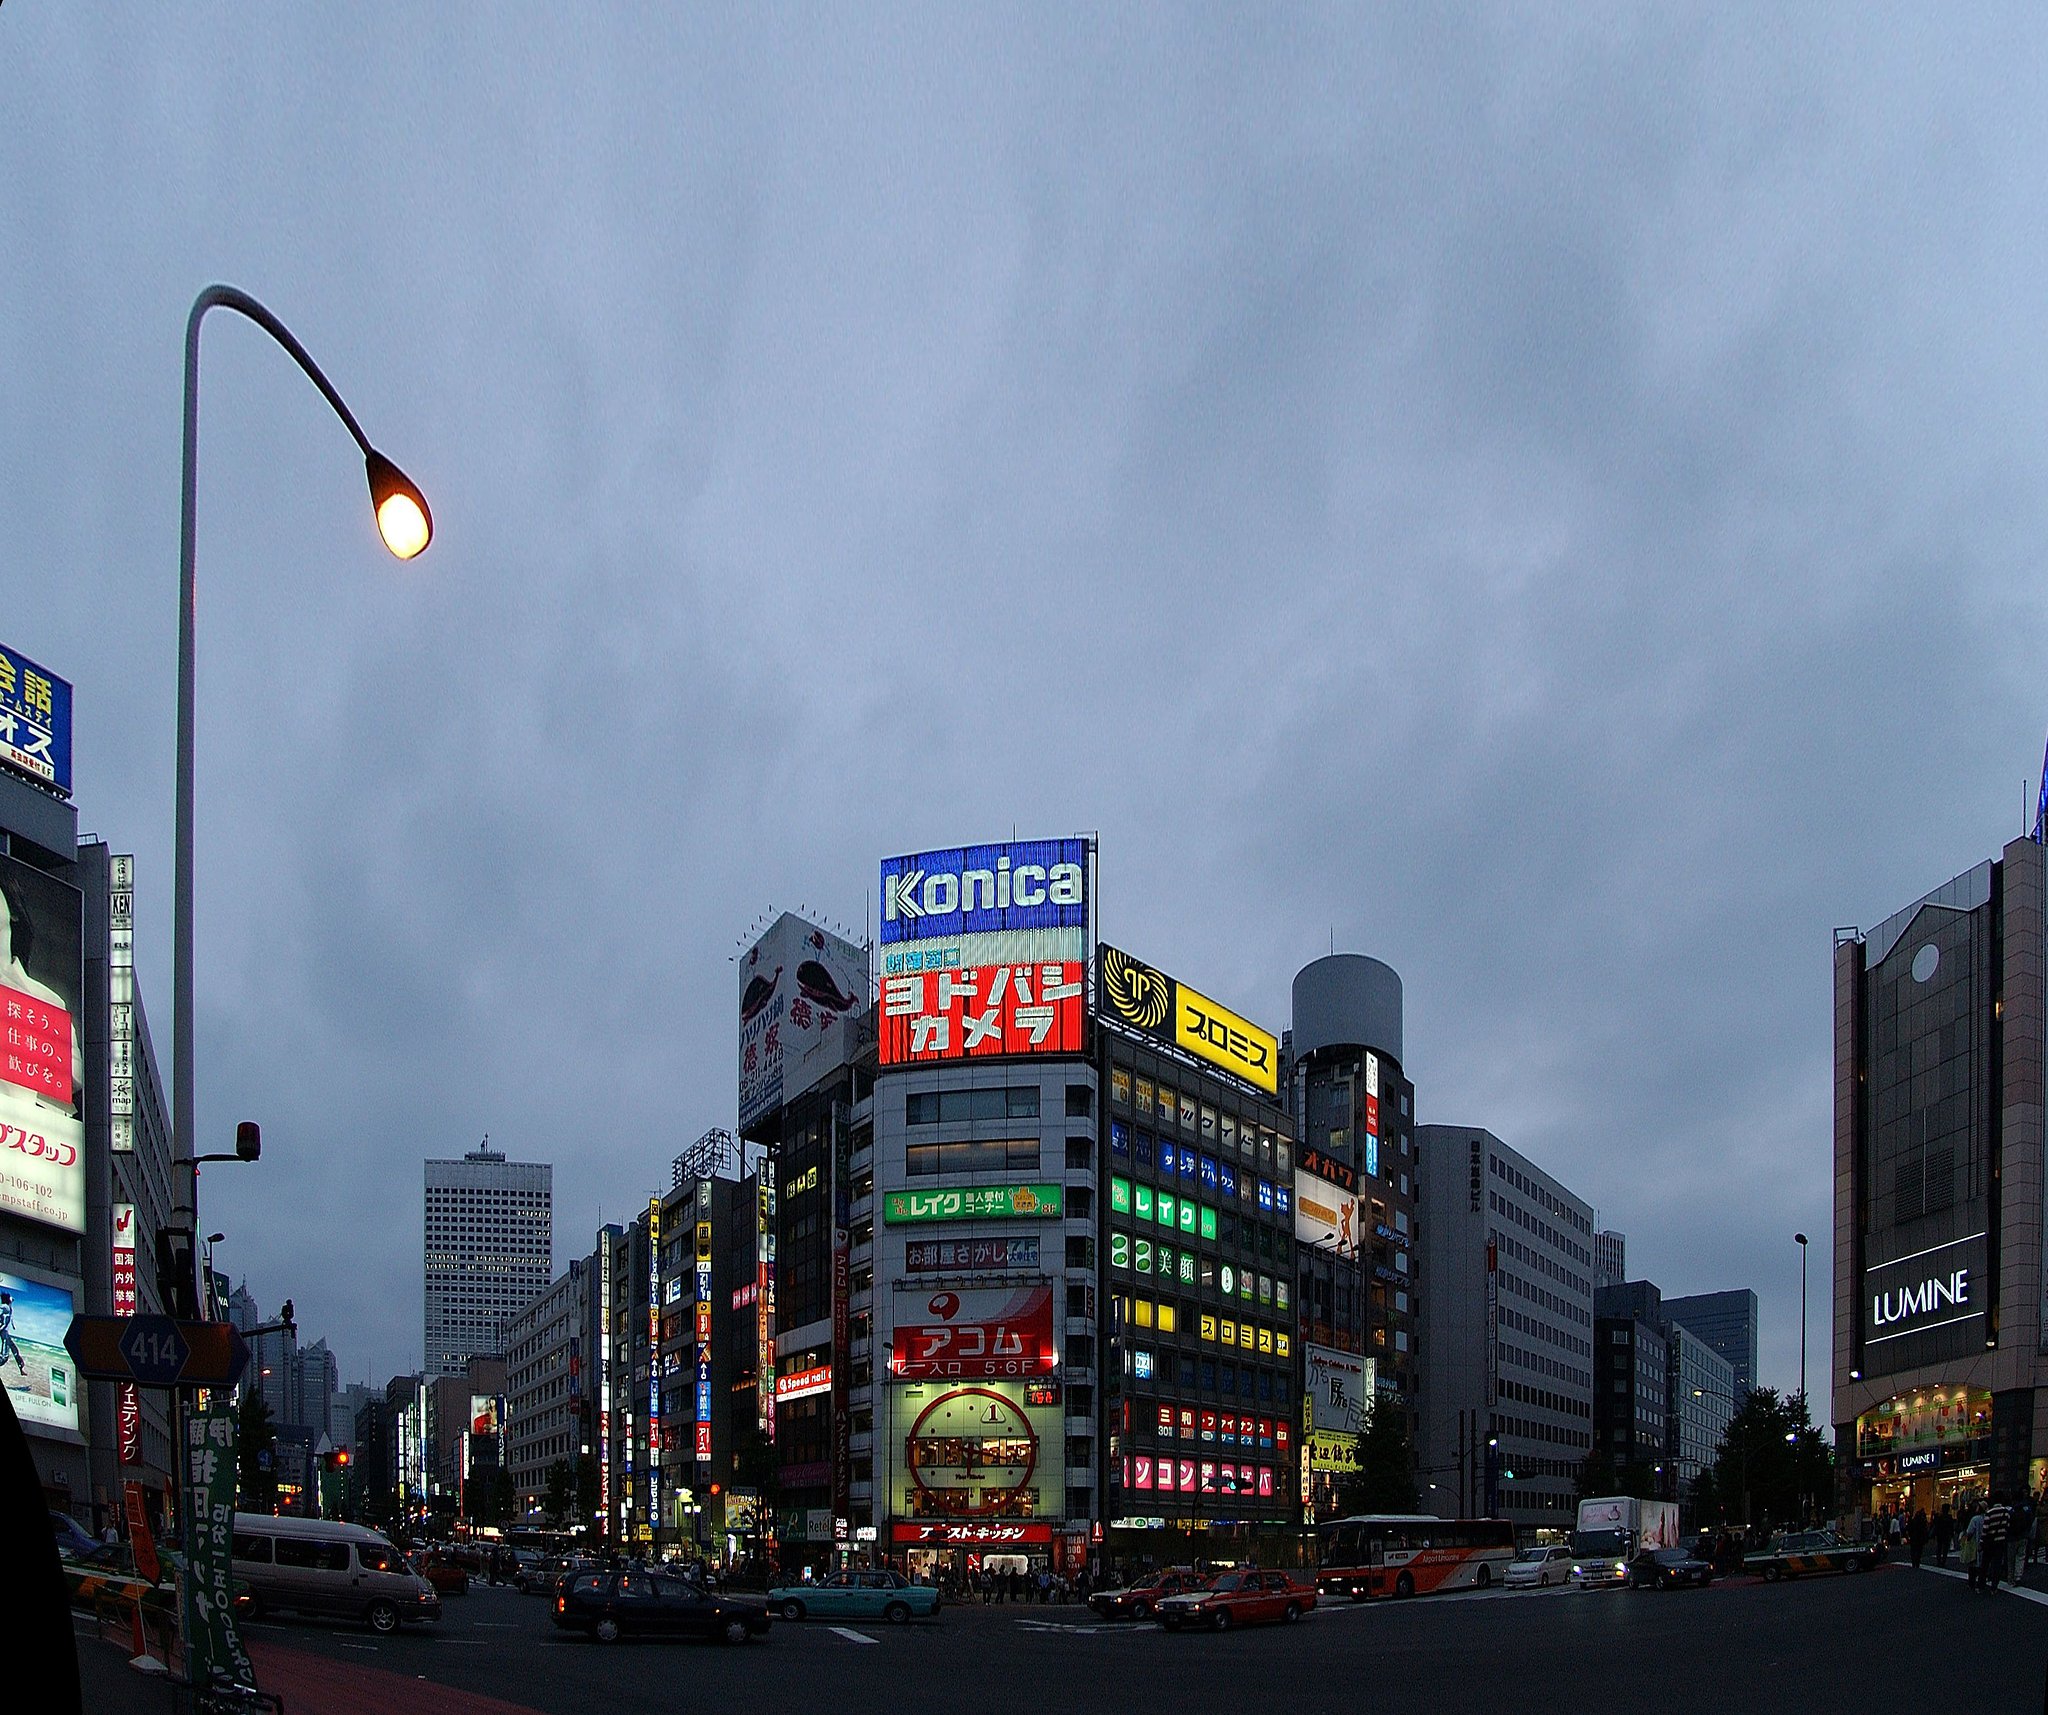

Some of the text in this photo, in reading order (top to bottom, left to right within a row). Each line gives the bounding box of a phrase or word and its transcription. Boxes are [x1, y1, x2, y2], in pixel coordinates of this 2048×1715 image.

[113, 895, 131, 914] KEN
[885, 857, 1082, 921] Konica
[885, 966, 1082, 1016] ヨドバシ
[7, 1000, 60, 1036] 探そう、
[911, 1006, 1054, 1053] カメラ
[7, 1027, 62, 1063] 仕事の、
[1186, 1004, 1269, 1074] プロミス
[8, 1053, 62, 1089] 歓びを。
[112, 1096, 131, 1106] map
[1303, 1149, 1353, 1187] オガワ
[910, 1192, 960, 1216] レイク
[965, 1203, 1005, 1214] コーナー
[1136, 1191, 1193, 1225] レイク
[908, 1242, 1005, 1267] お部屋さがし
[1158, 1249, 1194, 1282] 美顔
[1874, 1268, 1968, 1326] LUMINE
[130, 1332, 177, 1367] 414
[922, 1326, 1023, 1357] アコム
[1202, 1319, 1269, 1349] プロミス
[787, 1369, 826, 1390] Speed nail
[929, 1361, 962, 1375] 入口
[1902, 1455, 1931, 1468] LUMINE
[919, 1526, 1026, 1540] フスト・キッチン
